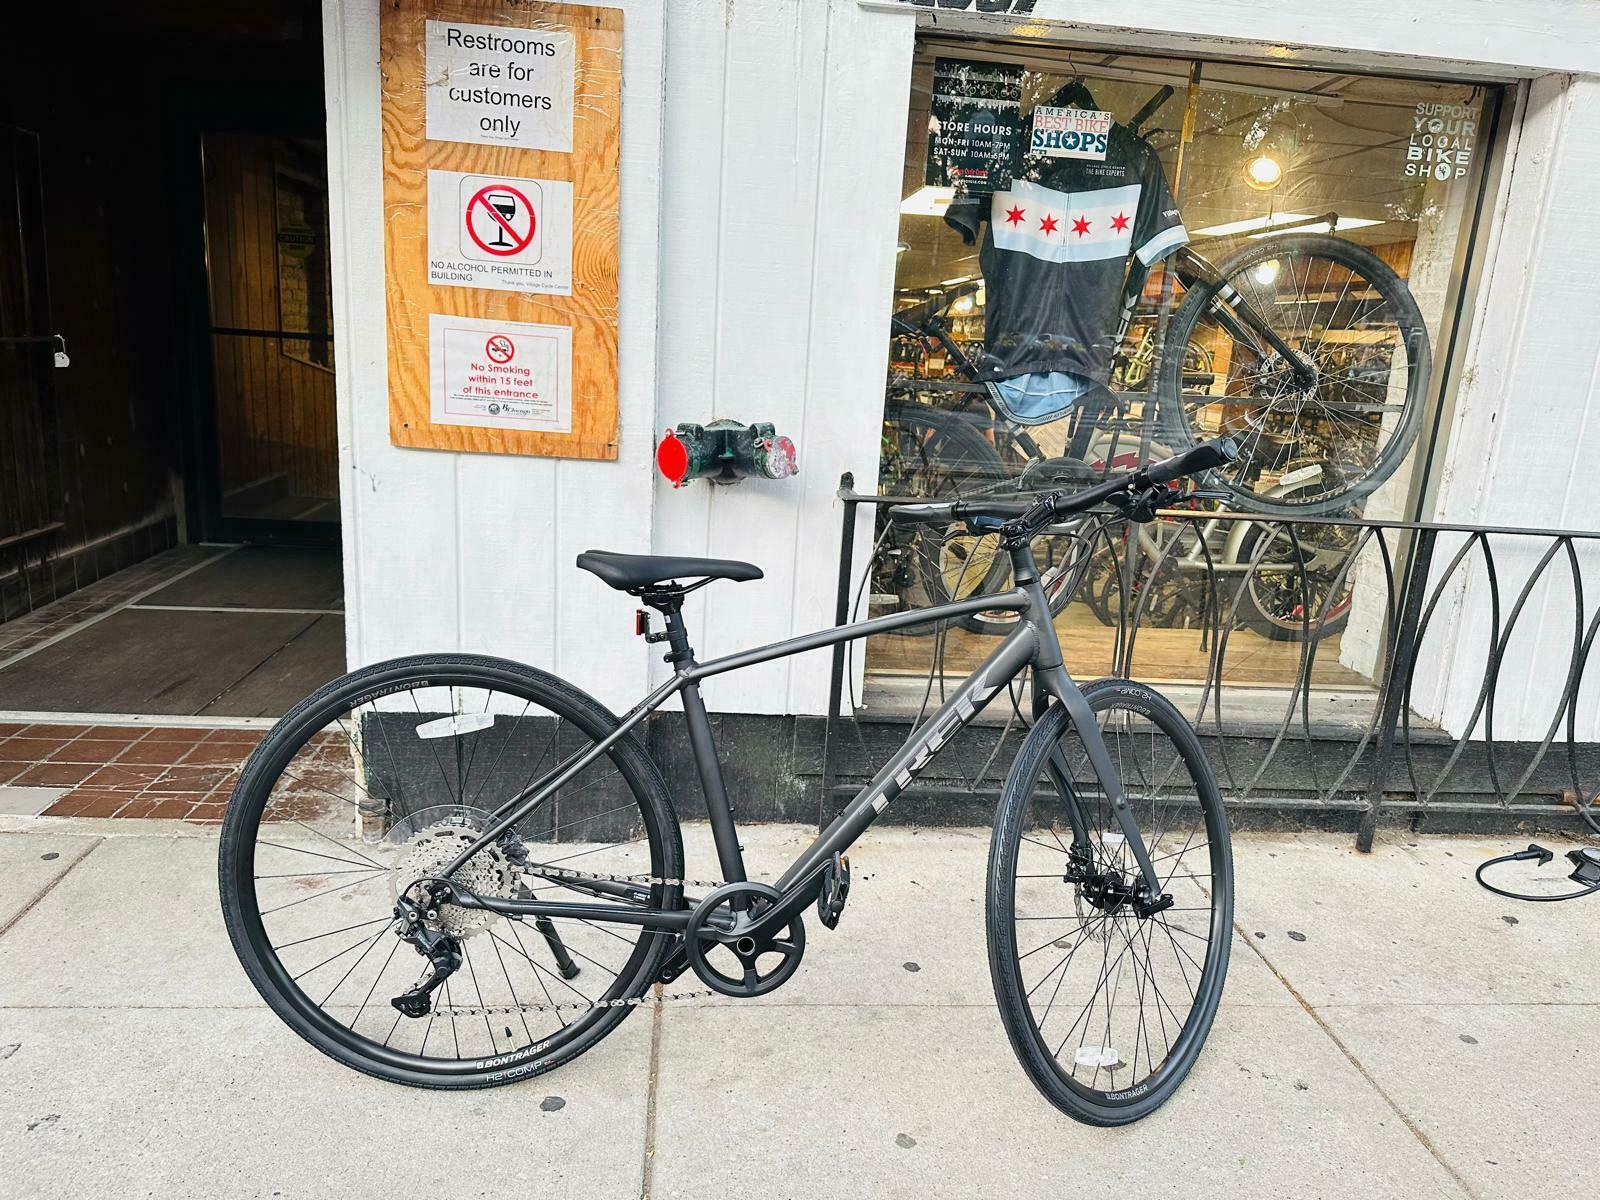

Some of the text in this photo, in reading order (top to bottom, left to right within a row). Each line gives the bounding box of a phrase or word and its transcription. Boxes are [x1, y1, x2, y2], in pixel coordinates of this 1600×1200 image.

[447, 28, 556, 57] Restrooms
[469, 62, 535, 81] are for
[449, 87, 552, 110] customers
[1036, 106, 1110, 121] AMERICA'S
[1415, 102, 1480, 120] SUPPORT
[479, 115, 521, 138] only
[974, 123, 1012, 136] HOURS
[1034, 115, 1109, 133] BEST BIKE
[1413, 116, 1476, 137] YOUR
[934, 137, 970, 147] MON-FRI
[1032, 128, 1107, 153] SHOPS
[1409, 133, 1472, 151] LOCAL
[933, 147, 967, 157] SAT-SUN
[1406, 146, 1471, 165] BIKE
[1404, 162, 1467, 181] SHOP
[431, 261, 553, 278] NO ALCOHOL PERMITTED IN
[431, 271, 473, 281] BUILDING
[471, 363, 531, 377] No Smoking
[468, 375, 533, 387] within 15 feet
[463, 386, 540, 399] of this entrance
[350, 681, 422, 708] BONTRAGER
[1120, 687, 1152, 701] H2 COMP
[858, 672, 998, 816] TREK
[484, 1040, 550, 1068] BONTRAGER
[486, 1072, 503, 1082] H2
[507, 1061, 542, 1078] COMP
[1110, 1084, 1148, 1101] BONTRAGER
